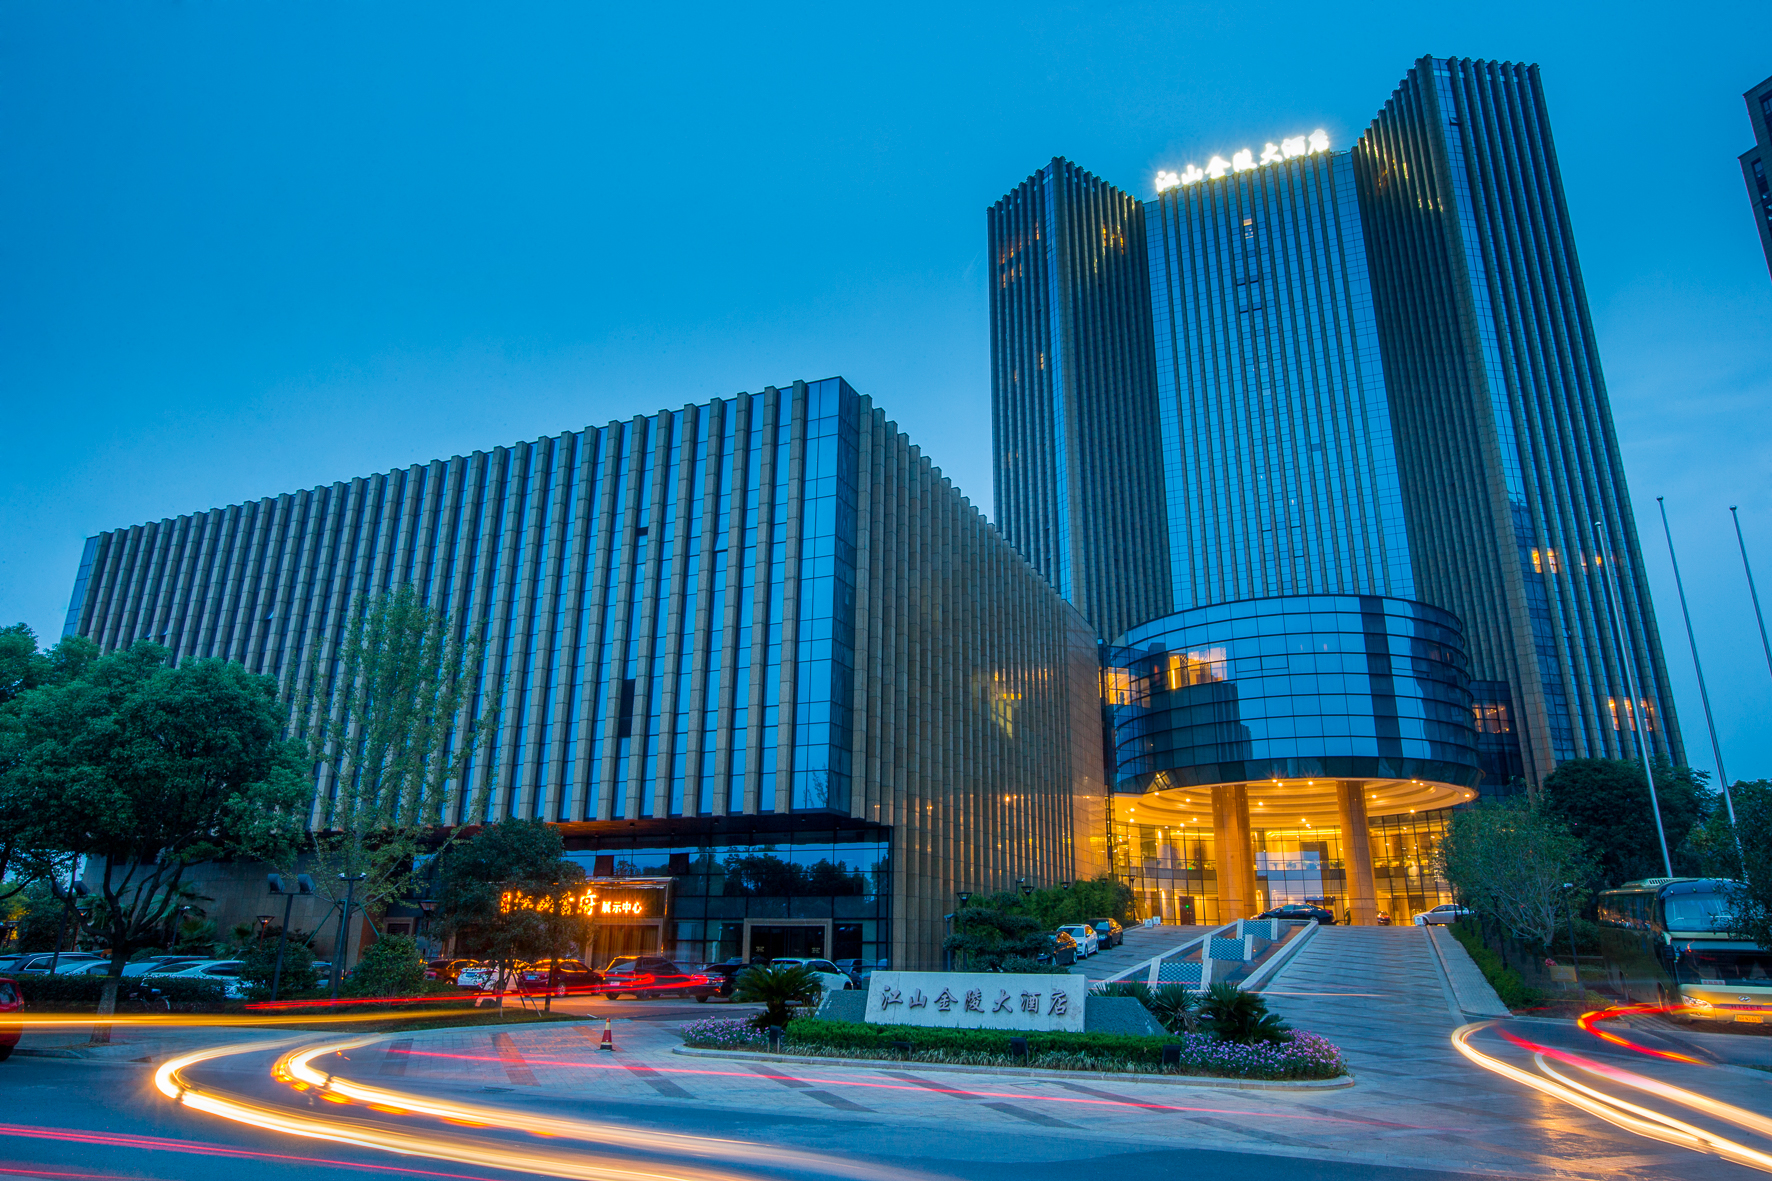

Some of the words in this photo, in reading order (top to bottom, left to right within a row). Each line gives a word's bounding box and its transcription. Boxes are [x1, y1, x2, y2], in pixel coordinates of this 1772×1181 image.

[601, 900, 642, 914] 展示中心
[881, 985, 1068, 1015] 江山金陵大酒店
